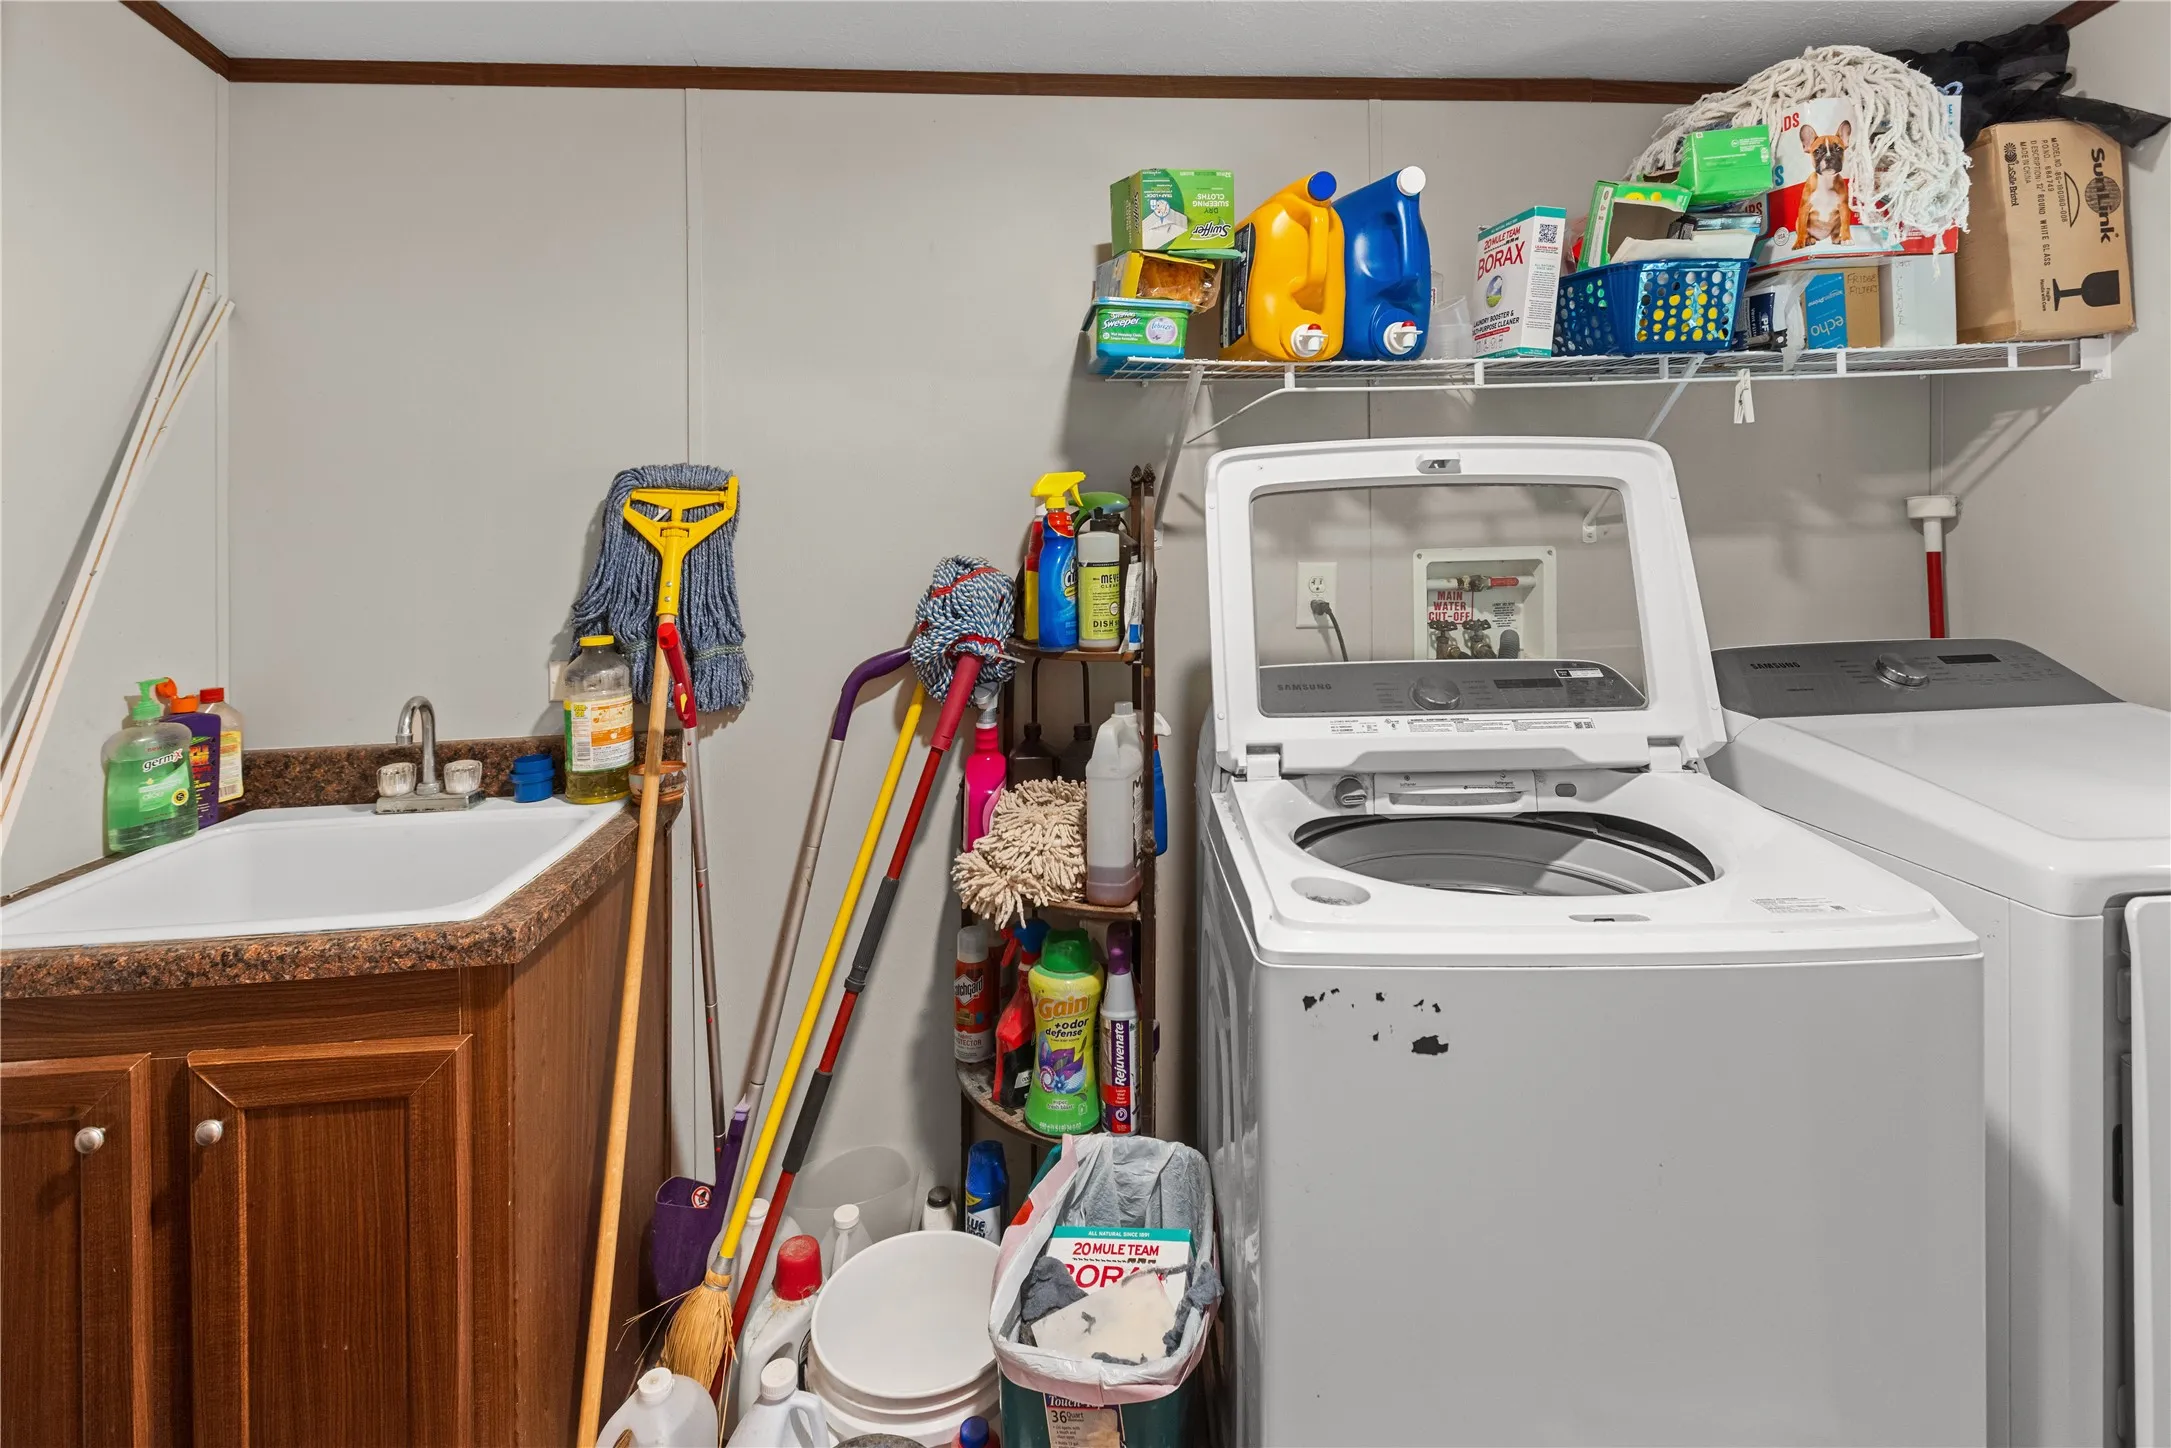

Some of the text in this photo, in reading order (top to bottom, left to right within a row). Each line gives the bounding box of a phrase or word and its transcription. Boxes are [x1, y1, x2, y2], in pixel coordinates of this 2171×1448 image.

[1780, 112, 1800, 132] DS
[2037, 194, 2046, 215] ROUND
[1193, 222, 1231, 237] Swiffer
[2040, 219, 2050, 240] WHITE
[1477, 241, 1525, 281] BORAX
[2043, 243, 2051, 266] GLASS
[1102, 317, 1142, 330] Sweeper
[1497, 316, 1520, 328] CLEANER
[1810, 315, 1844, 336] echo
[1101, 573, 1120, 584] MEYE
[1437, 591, 1463, 600] MAIN
[1433, 602, 1466, 611] WATER
[1428, 611, 1471, 622] CUT-OFF
[1093, 620, 1114, 628] DISH
[1277, 683, 1332, 691] SAMSUNG
[1039, 995, 1088, 1019] Gain
[1055, 1018, 1089, 1029] +odor
[1046, 1028, 1082, 1038] defense
[1114, 1023, 1127, 1086] Rejuvenate
[967, 1216, 986, 1232] LUE
[1072, 1242, 1160, 1256] 20 MULE TEAM
[1051, 1410, 1085, 1423] 36 Quart
